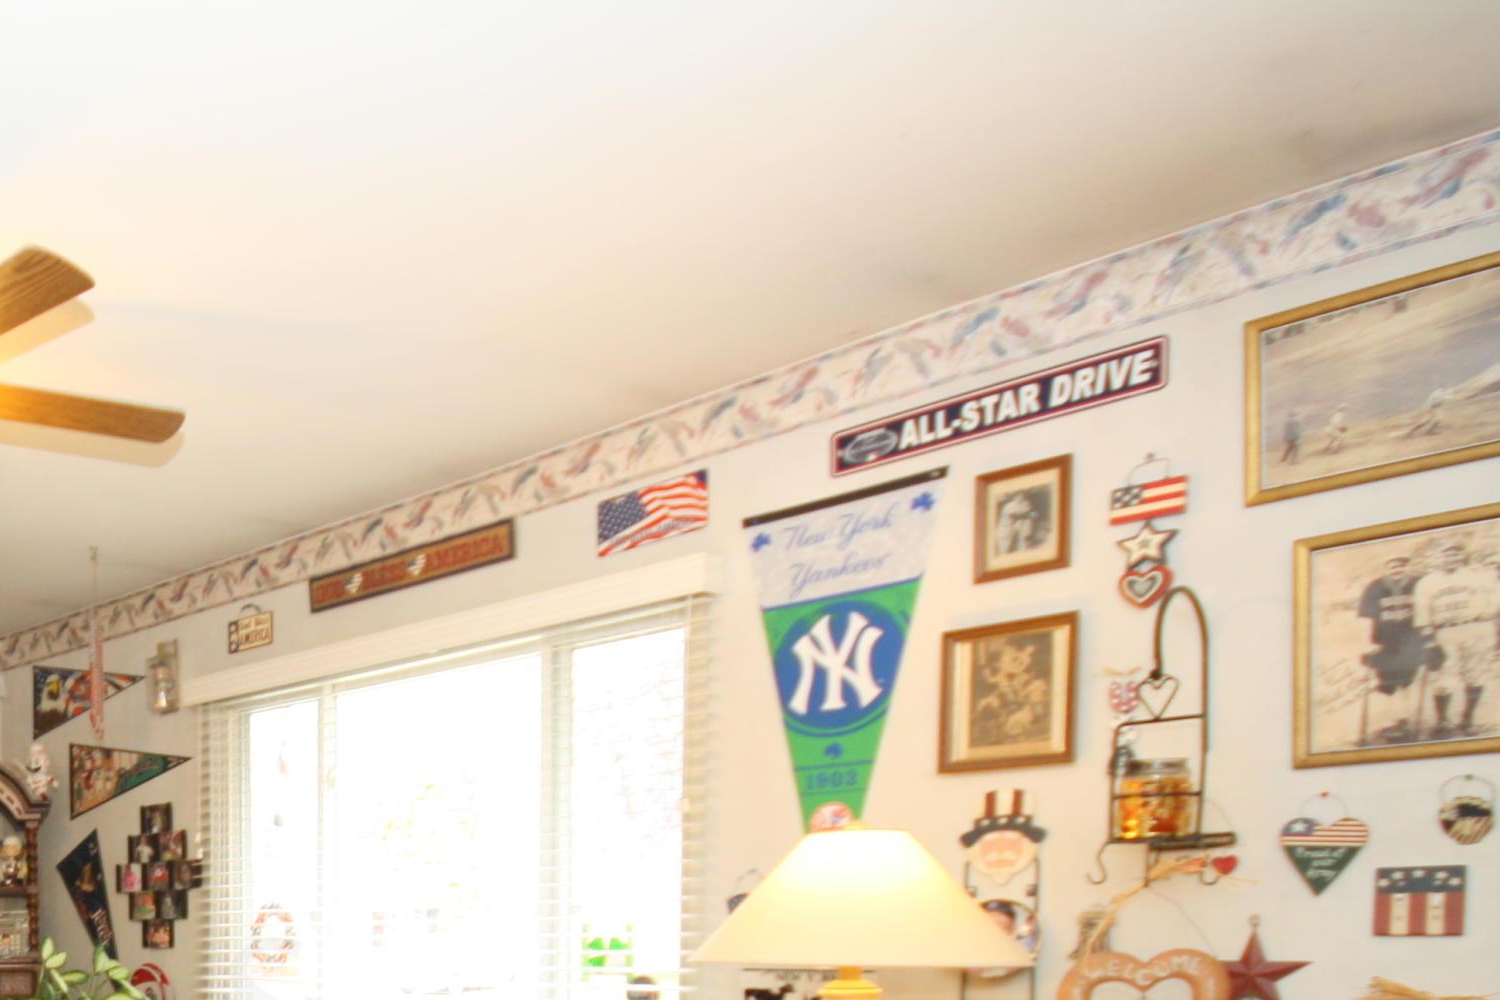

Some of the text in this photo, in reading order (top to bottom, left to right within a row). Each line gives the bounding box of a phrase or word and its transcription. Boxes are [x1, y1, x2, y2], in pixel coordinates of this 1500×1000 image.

[900, 382, 1041, 450] ALL-STAR
[1049, 349, 1156, 406] DRIVE
[782, 500, 902, 553] New York
[425, 532, 505, 571] AMERICA
[787, 549, 893, 603] Yankees
[239, 627, 269, 647] AMERICA
[1087, 955, 1200, 985] WELCOME
